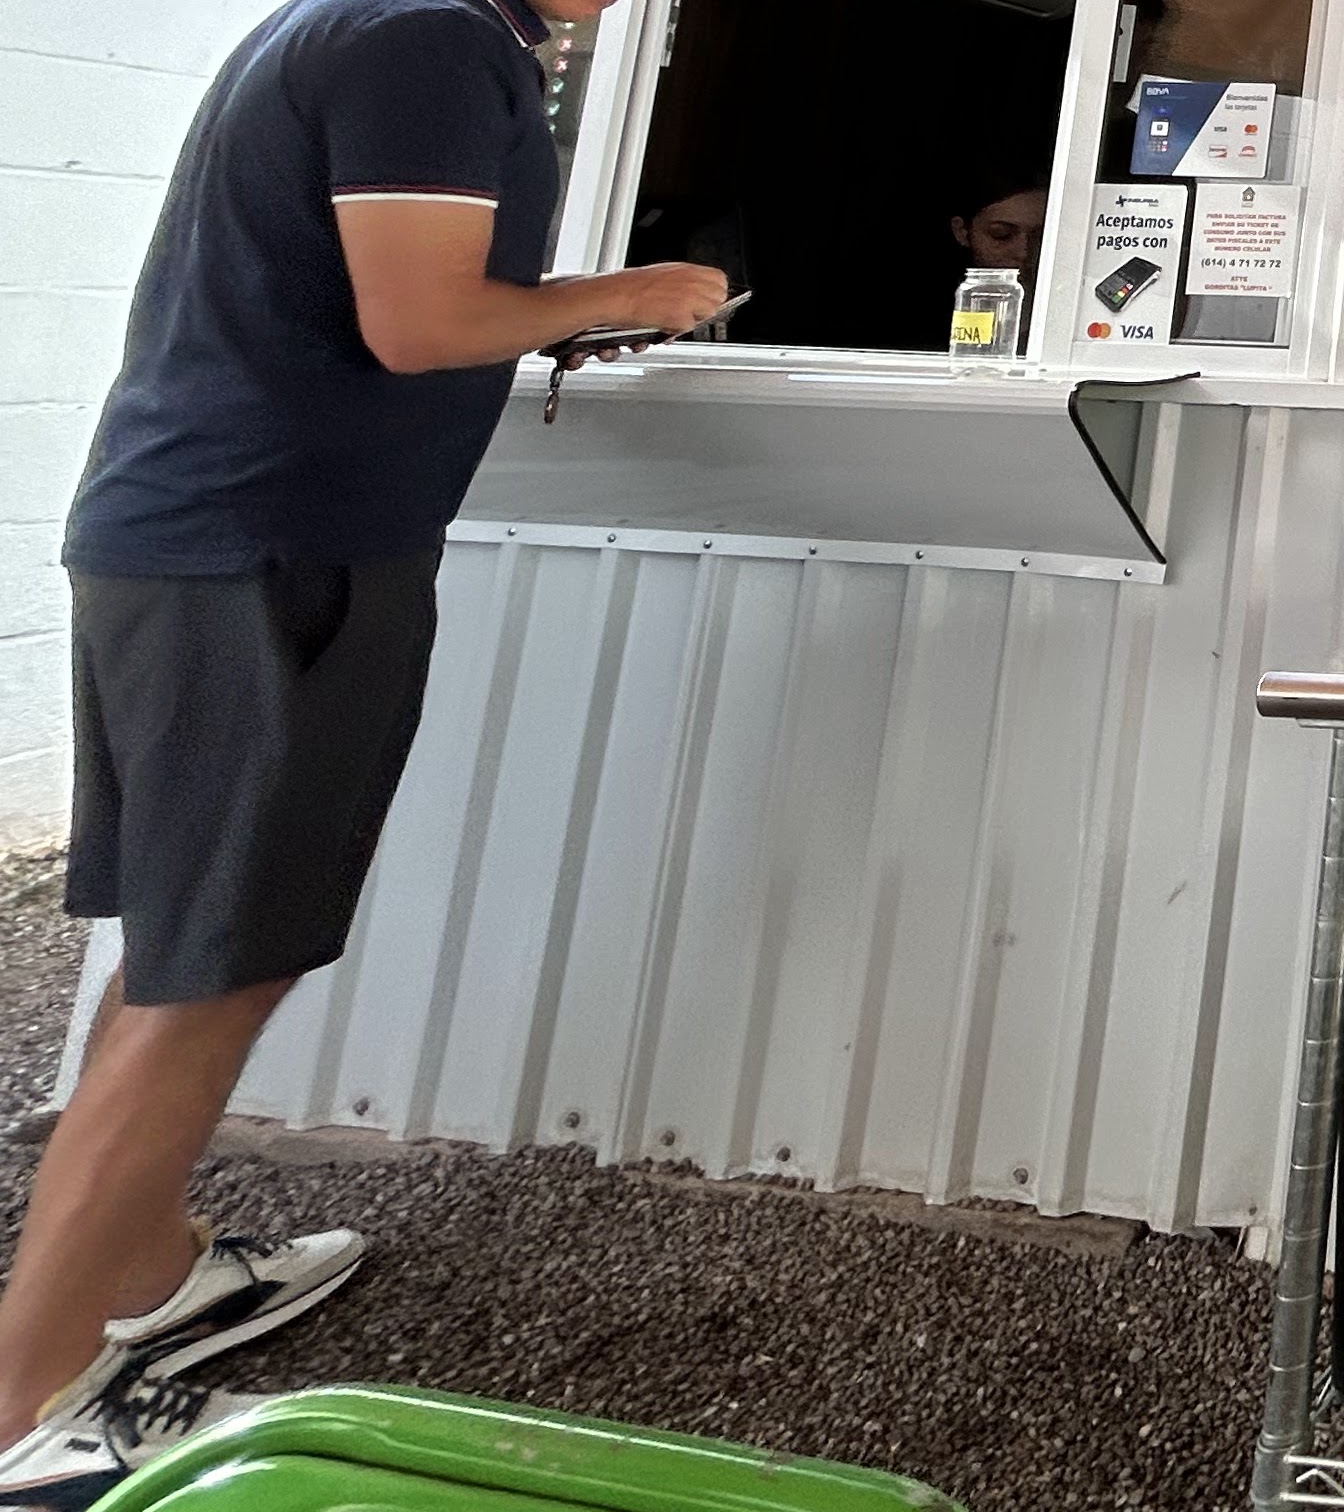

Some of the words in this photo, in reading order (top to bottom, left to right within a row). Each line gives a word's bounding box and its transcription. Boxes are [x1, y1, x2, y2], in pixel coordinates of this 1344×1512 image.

[1096, 213, 1174, 231] Aceptamos
[1096, 235, 1140, 250] pagos
[1142, 236, 1168, 248] con
[1201, 258, 1226, 268] (614)
[1229, 259, 1235, 267] 4
[1239, 259, 1250, 267] 71
[1254, 259, 1266, 268] 72
[1269, 259, 1281, 268] 72
[1120, 324, 1154, 339] VISA
